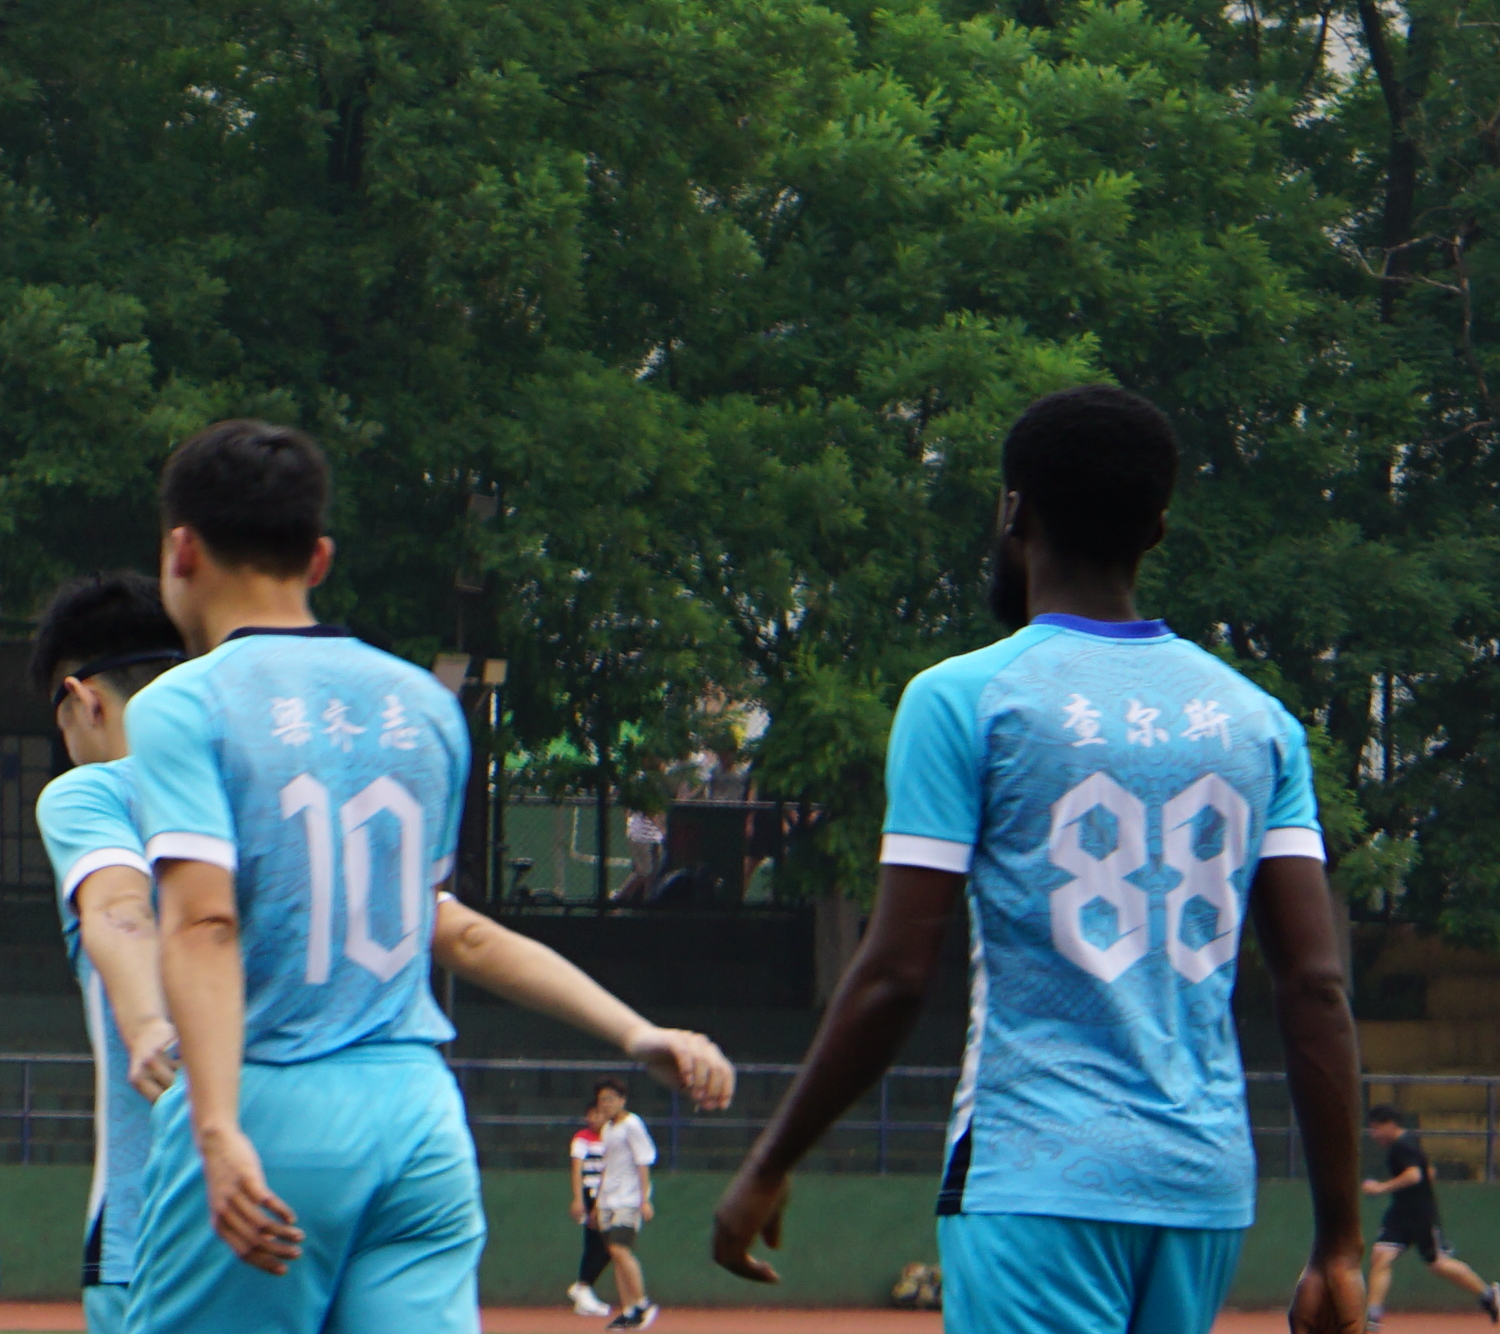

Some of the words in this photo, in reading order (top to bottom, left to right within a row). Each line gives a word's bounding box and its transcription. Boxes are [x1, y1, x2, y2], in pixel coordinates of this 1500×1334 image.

[1062, 693, 1233, 751] 查尔斯
[280, 772, 424, 984] 10
[1050, 771, 1248, 984] 88
